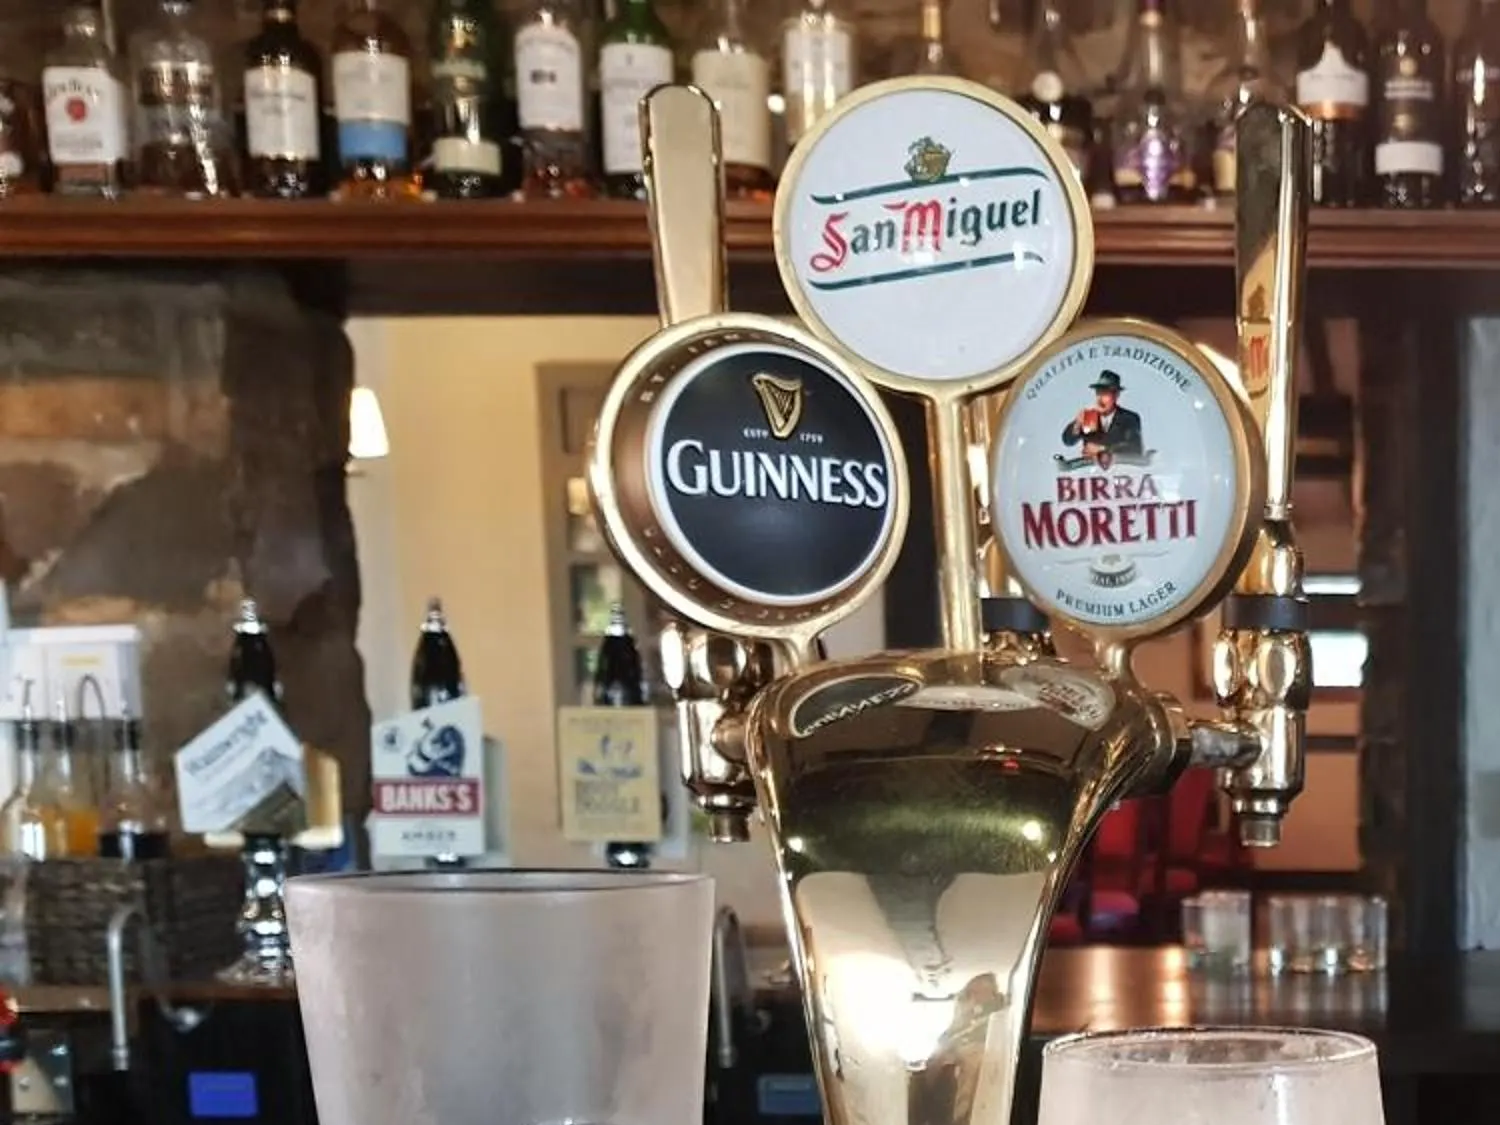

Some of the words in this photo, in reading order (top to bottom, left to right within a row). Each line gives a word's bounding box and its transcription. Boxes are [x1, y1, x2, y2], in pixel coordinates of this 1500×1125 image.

[810, 211, 896, 272] San
[884, 189, 1041, 253] Miguel
[1102, 344, 1193, 391] TRADIZIONE
[667, 439, 887, 509] GUINNESS
[1056, 474, 1159, 502] BIRRA
[1022, 500, 1197, 549] MORETTI
[1055, 587, 1125, 617] PREMIUM
[1129, 580, 1177, 614] LAGER
[381, 784, 472, 811] BANKS'S
